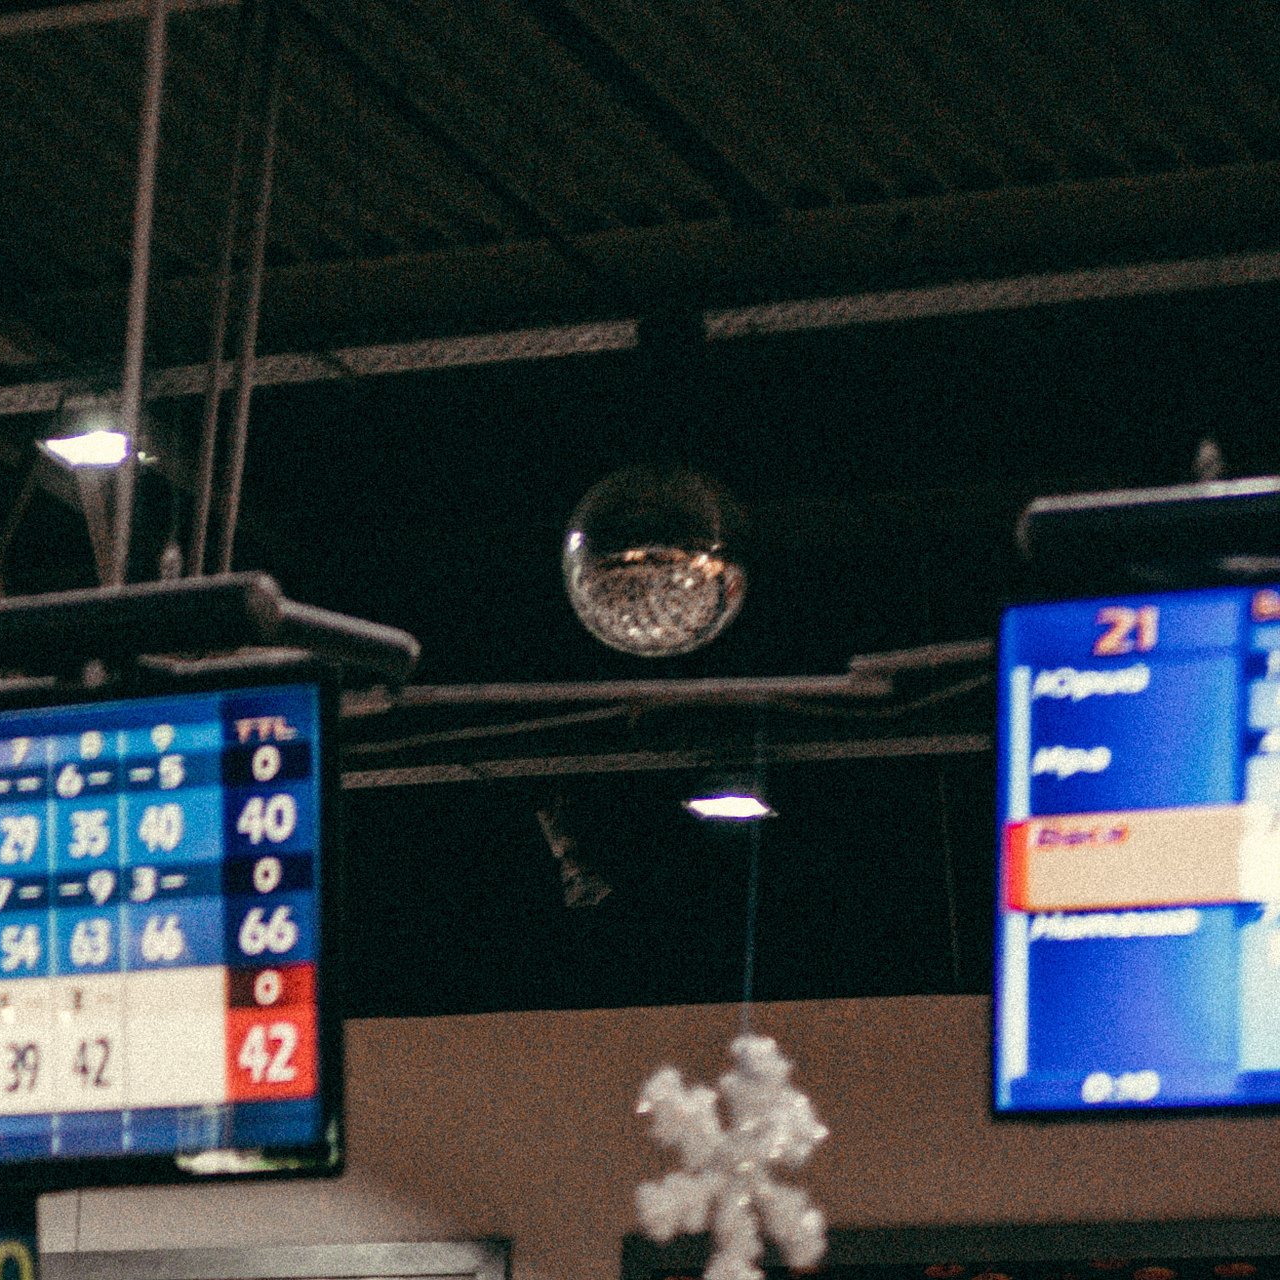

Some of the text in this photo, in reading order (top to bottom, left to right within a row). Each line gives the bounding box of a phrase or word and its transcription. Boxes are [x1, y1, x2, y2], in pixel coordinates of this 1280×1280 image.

[1093, 605, 1160, 656] 21
[69, 808, 111, 859] 35
[138, 802, 184, 853] 40
[237, 792, 297, 845] 40
[238, 905, 298, 956] 66
[5, 1042, 41, 1092] 39
[74, 1037, 110, 1088] 42
[237, 1020, 299, 1085] 42
